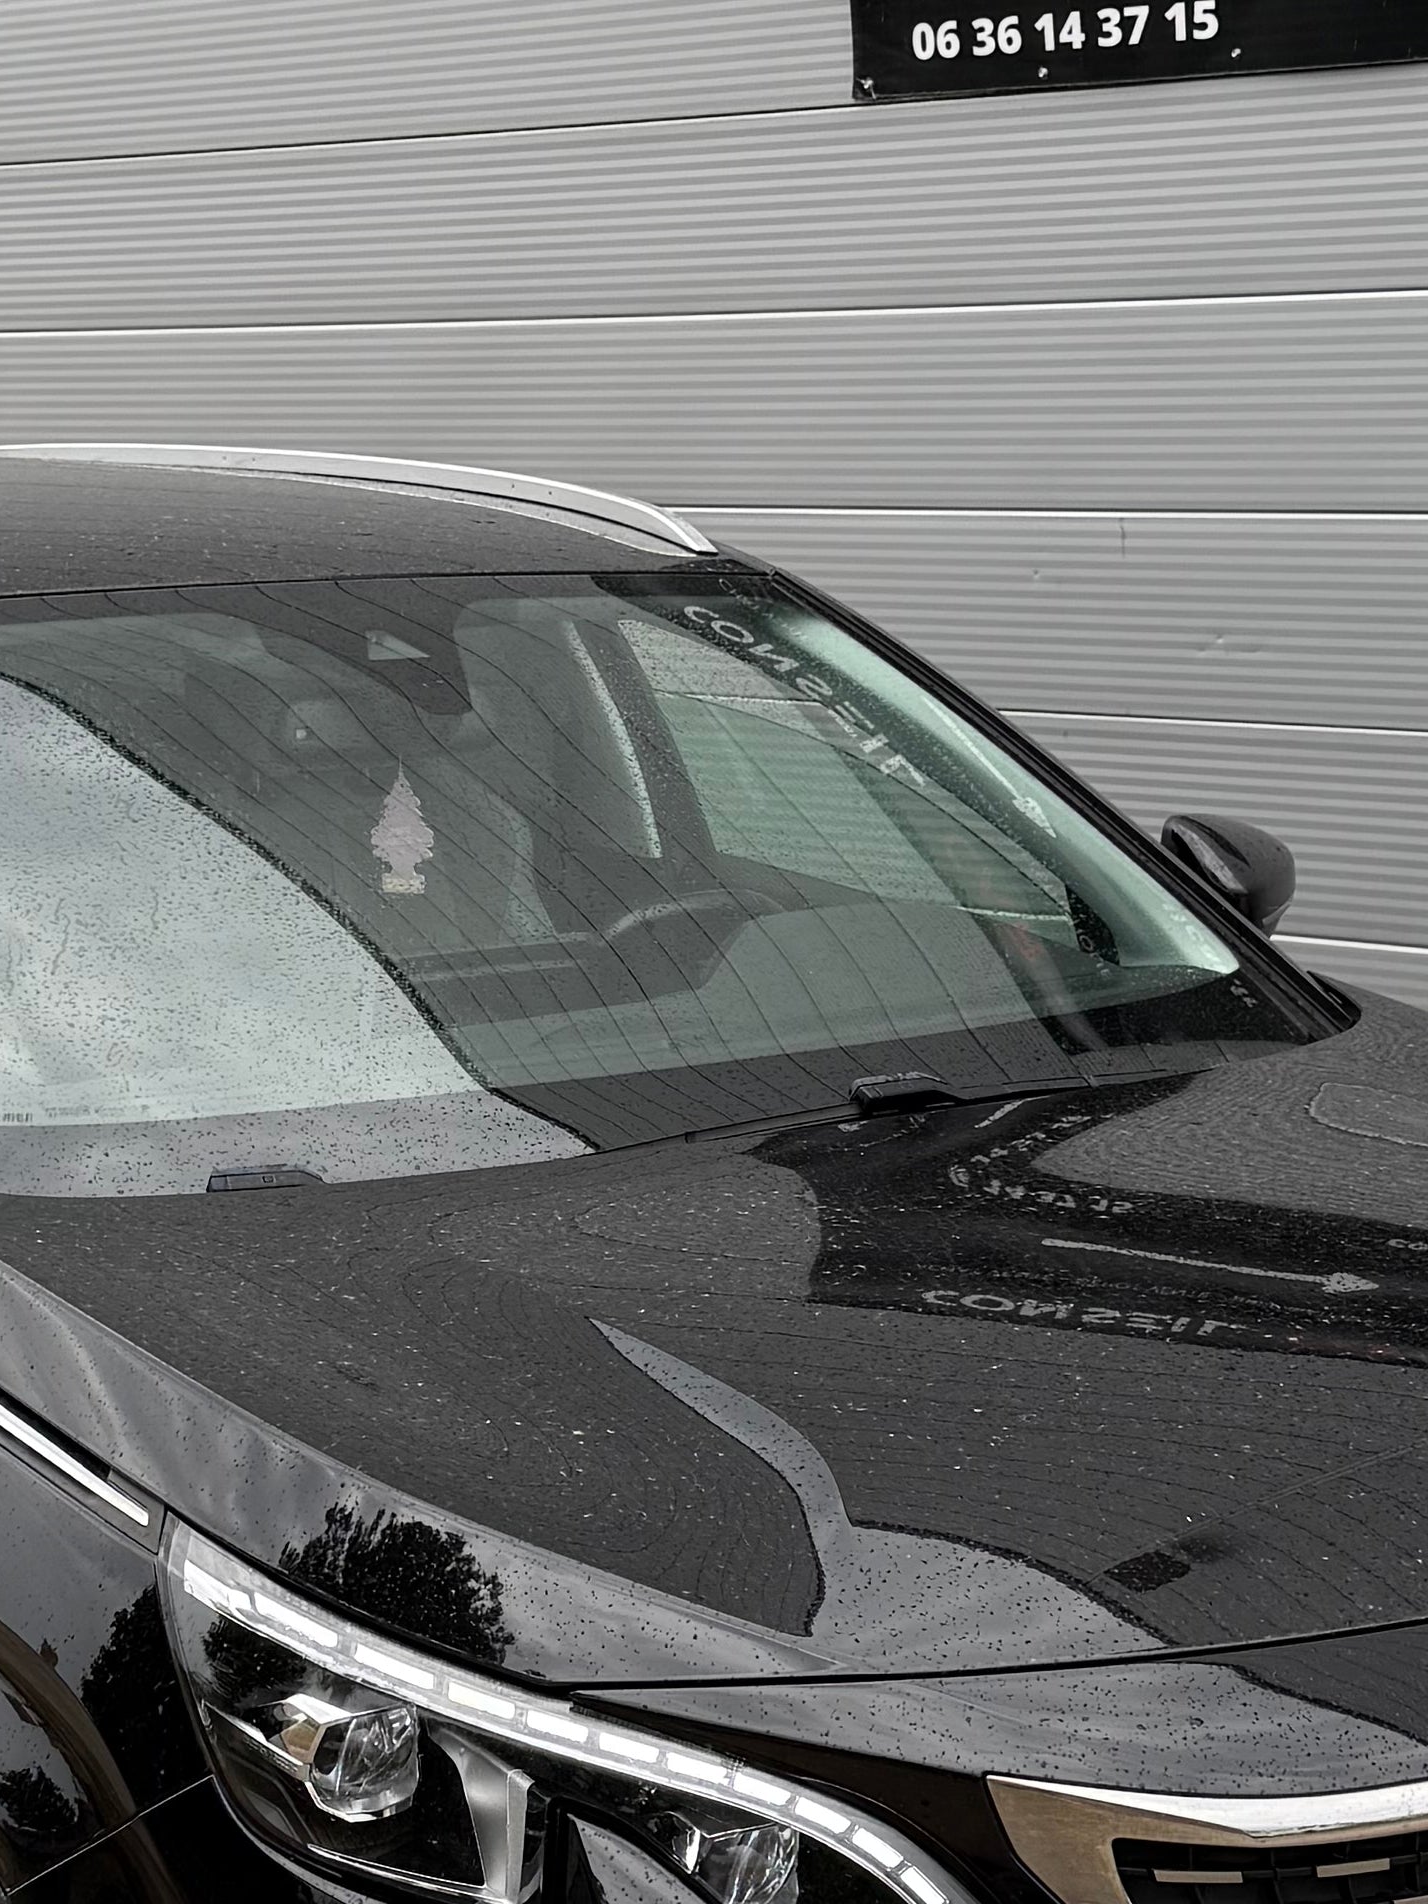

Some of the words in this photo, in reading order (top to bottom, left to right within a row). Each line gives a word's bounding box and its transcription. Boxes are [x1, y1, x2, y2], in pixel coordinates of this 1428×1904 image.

[911, 20, 961, 62] 06
[971, 15, 1023, 58] 36
[1034, 10, 1086, 53] 14
[1096, 5, 1150, 48] 37
[1164, 0, 1220, 42] 15
